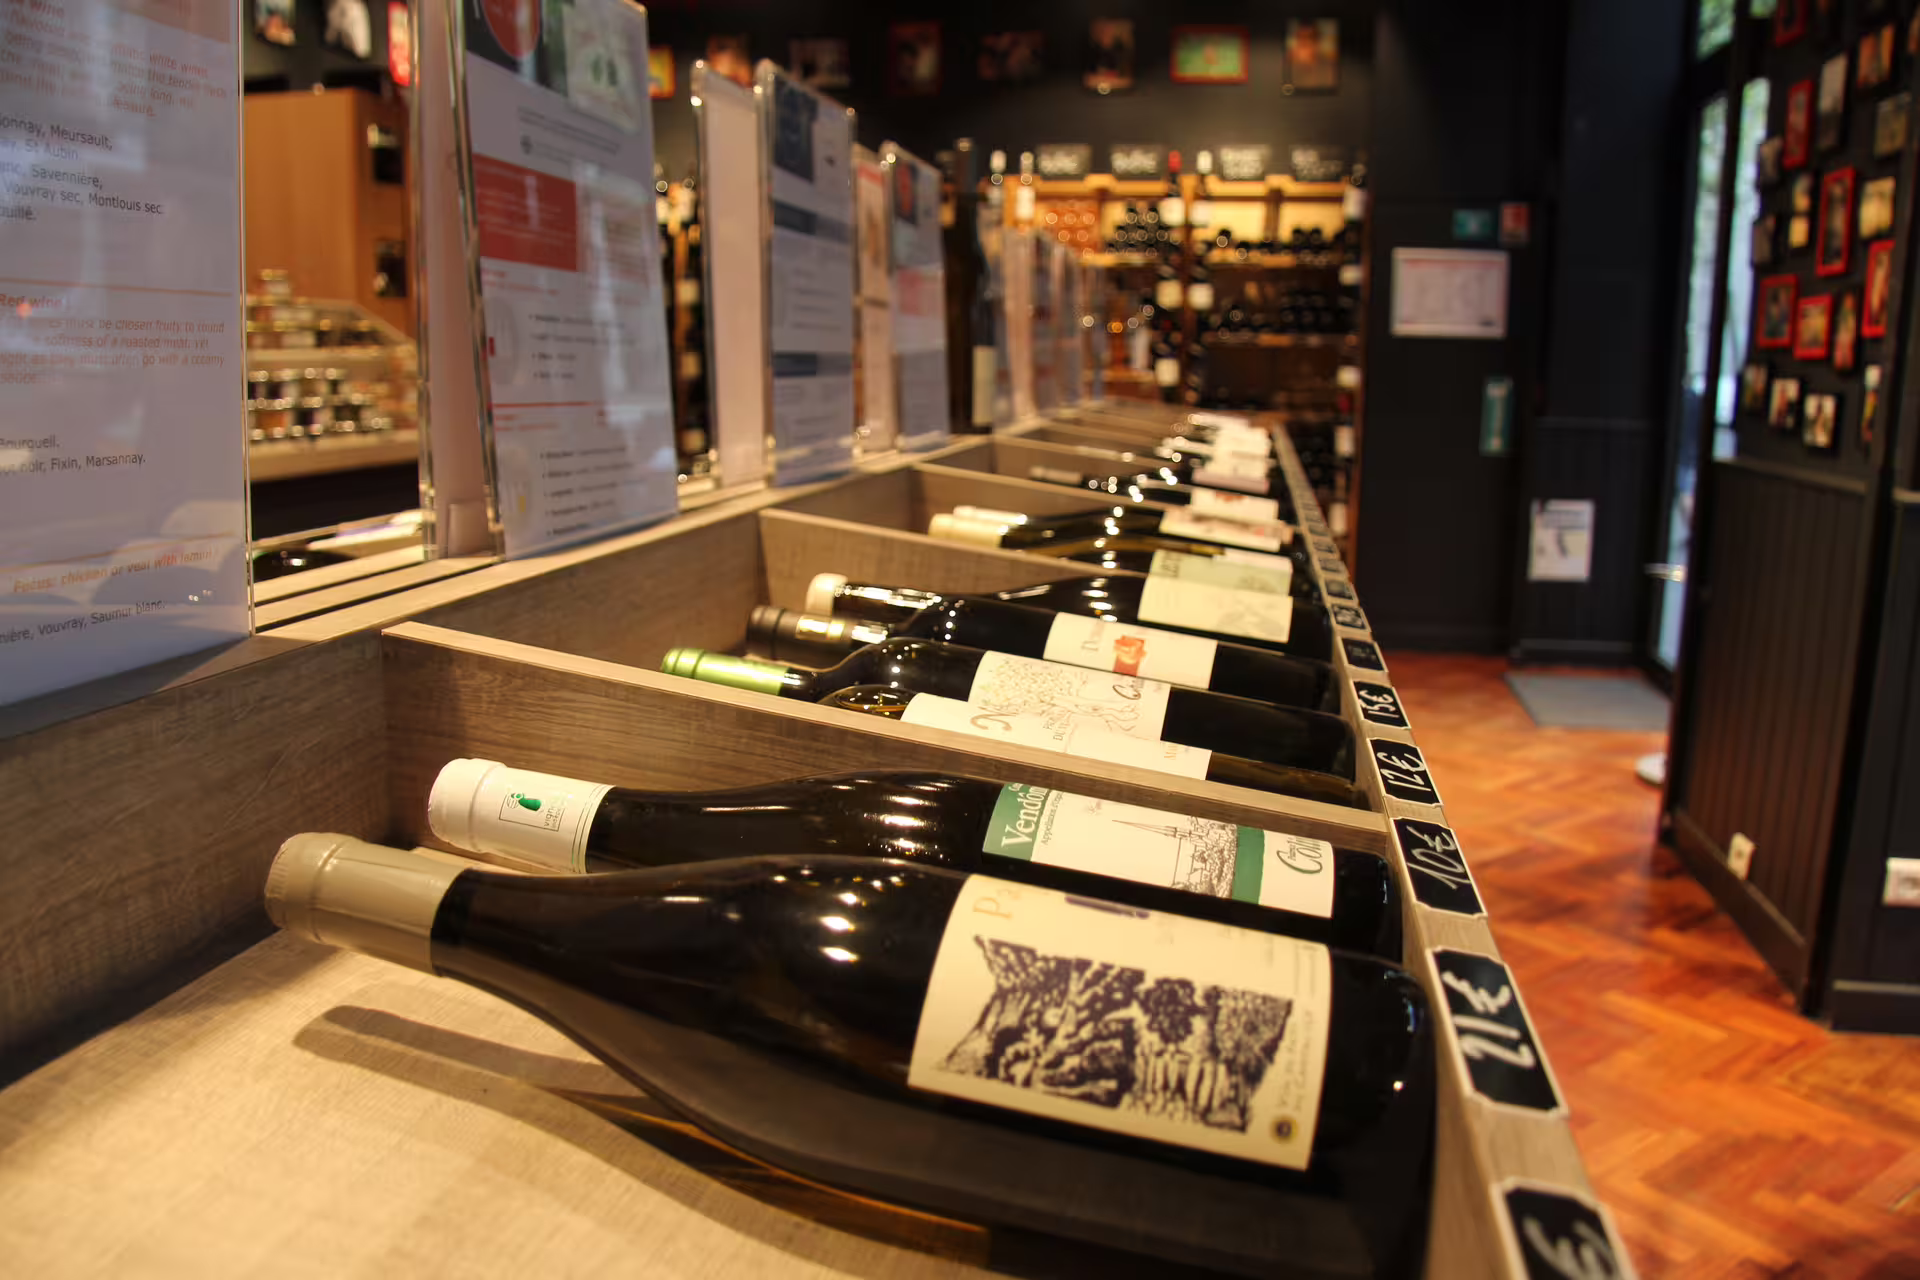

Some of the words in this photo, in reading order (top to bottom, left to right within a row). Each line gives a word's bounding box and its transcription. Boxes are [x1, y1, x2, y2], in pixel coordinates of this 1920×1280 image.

[50, 124, 113, 151] Meursault,
[89, 191, 141, 213] Montlouis
[51, 455, 82, 471] Fixin,
[86, 452, 146, 469] Marsannay.
[38, 615, 88, 637] Vouvray,
[1358, 689, 1400, 718] 15€
[1376, 752, 1432, 792] 12€
[1404, 826, 1472, 890] 10€
[1440, 972, 1536, 1069] 21€
